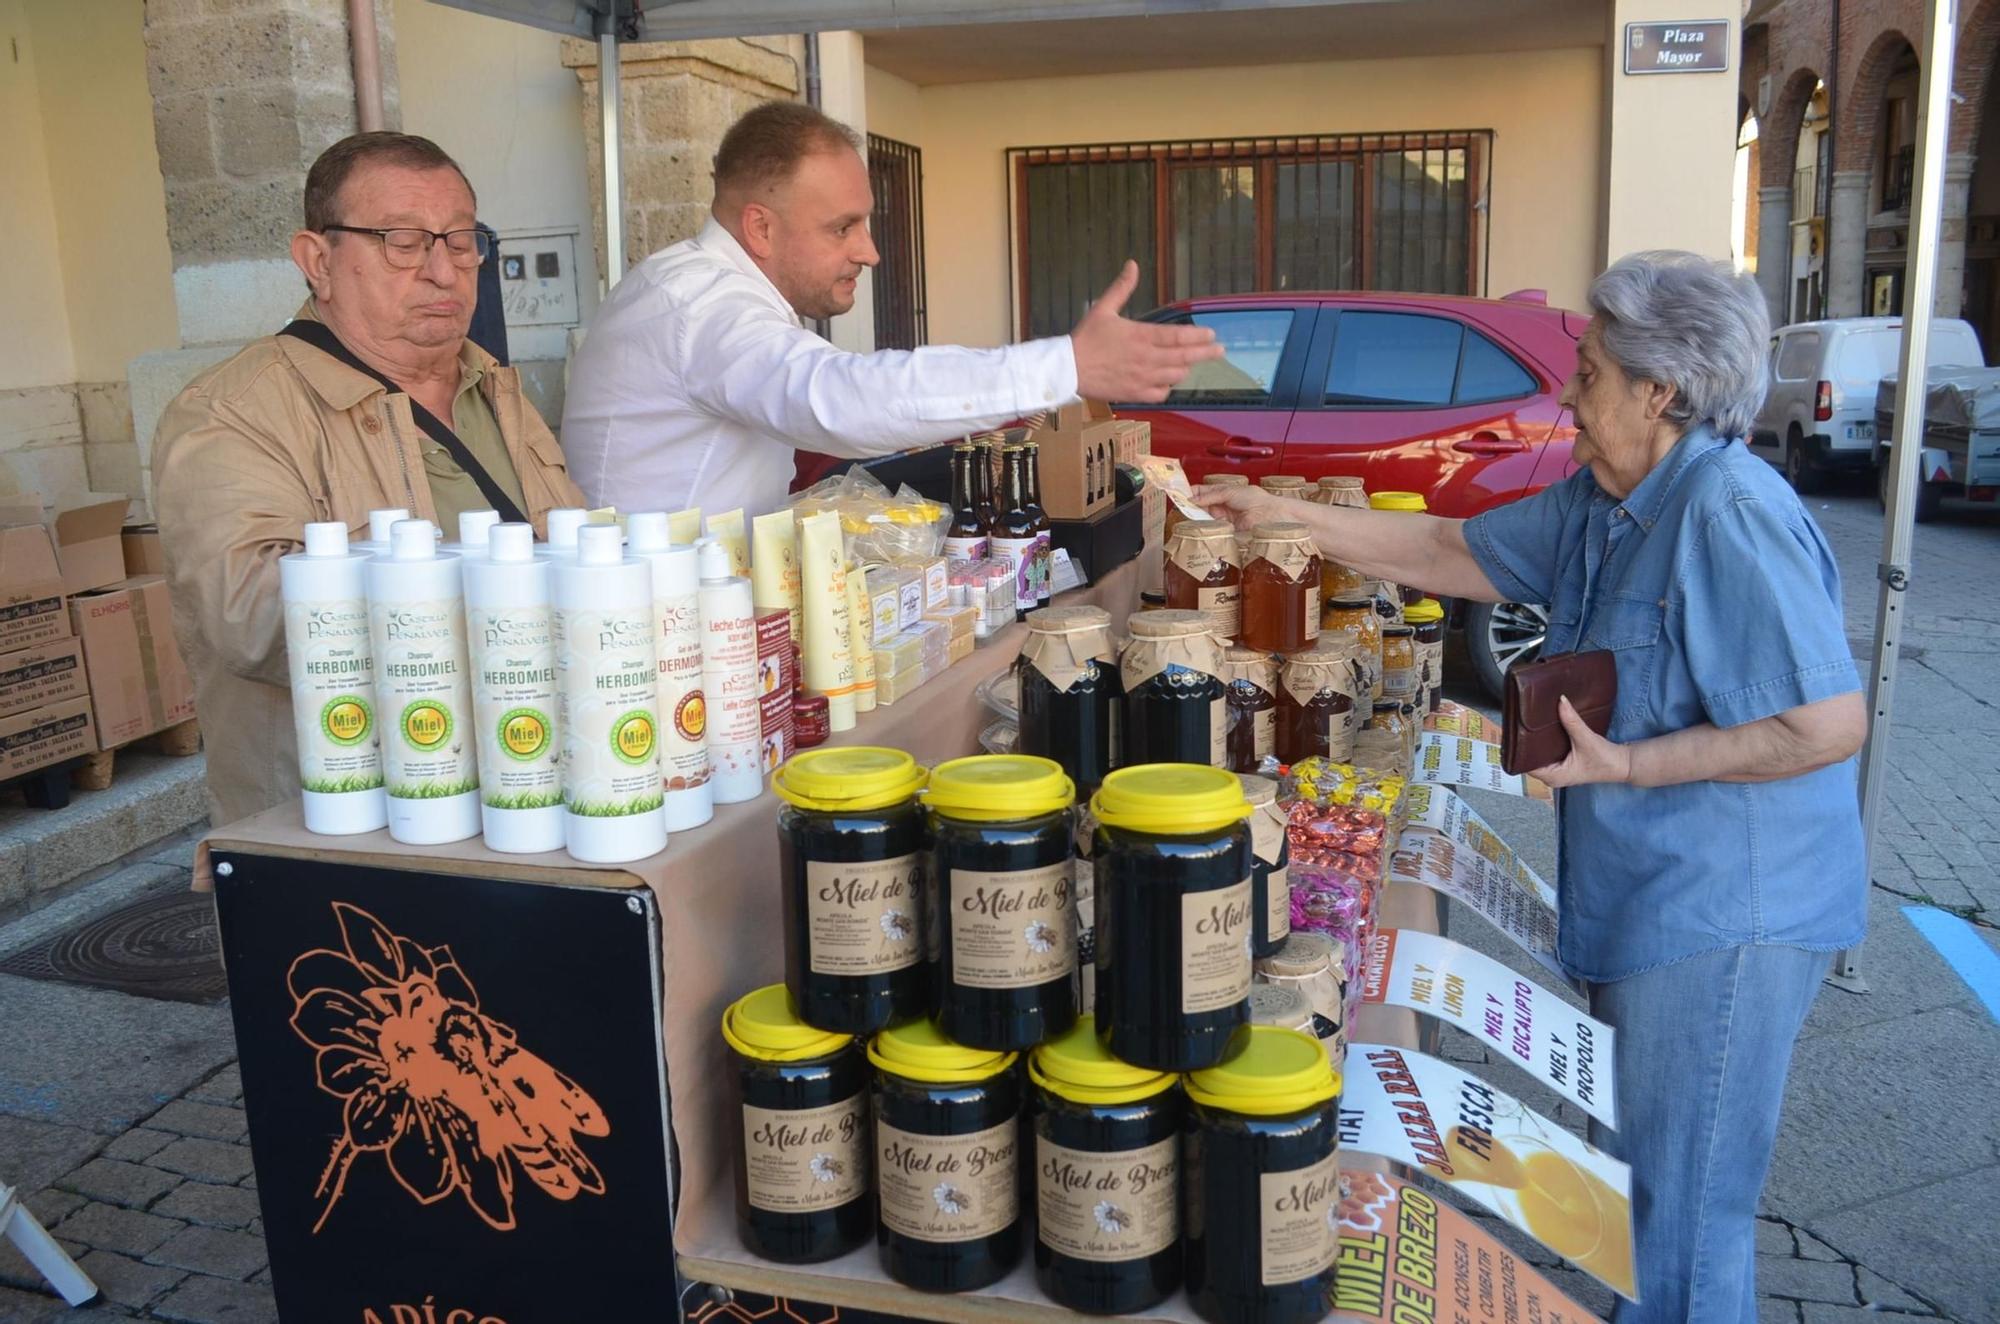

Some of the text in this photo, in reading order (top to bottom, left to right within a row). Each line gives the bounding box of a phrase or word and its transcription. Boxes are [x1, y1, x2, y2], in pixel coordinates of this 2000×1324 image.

[1663, 29, 1705, 43] Plaza
[1656, 51, 1703, 65] Mayor
[709, 620, 734, 632] Leche
[387, 660, 457, 678] HERBOMIEL
[484, 667, 557, 685] HERBOMIEL
[333, 713, 361, 728] Miel
[412, 717, 441, 732] Miel
[510, 725, 539, 741] Miel
[623, 730, 649, 745] Miel
[819, 878, 879, 909] Miel
[882, 876, 905, 899] de
[962, 887, 1024, 920] Miel
[1027, 887, 1050, 910] de
[1196, 900, 1246, 936] Miel
[1410, 964, 1434, 1004] MIEL Y
[1443, 973, 1465, 1018] LIMON
[1484, 993, 1504, 1041] MIEL Y
[1512, 981, 1533, 1061] EUCALIPTO
[1550, 1033, 1568, 1086] MIEL Y
[1576, 1022, 1594, 1106] PROPOLEO
[1365, 1049, 1455, 1175] JALEA REAL
[1457, 1080, 1495, 1162] FRESCA
[753, 1122, 808, 1153] Miel
[811, 1123, 834, 1144] de
[884, 1142, 933, 1176] Miel
[936, 1153, 961, 1173] de
[1043, 1158, 1093, 1193] Miel
[1096, 1170, 1121, 1190] de
[1275, 1176, 1327, 1212] Miel
[1395, 1185, 1438, 1291] BREZO
[1326, 1233, 1389, 1317] MIEL
[1454, 1238, 1470, 1308] ACONSEJA
[1479, 1247, 1493, 1318] COMBATIR
